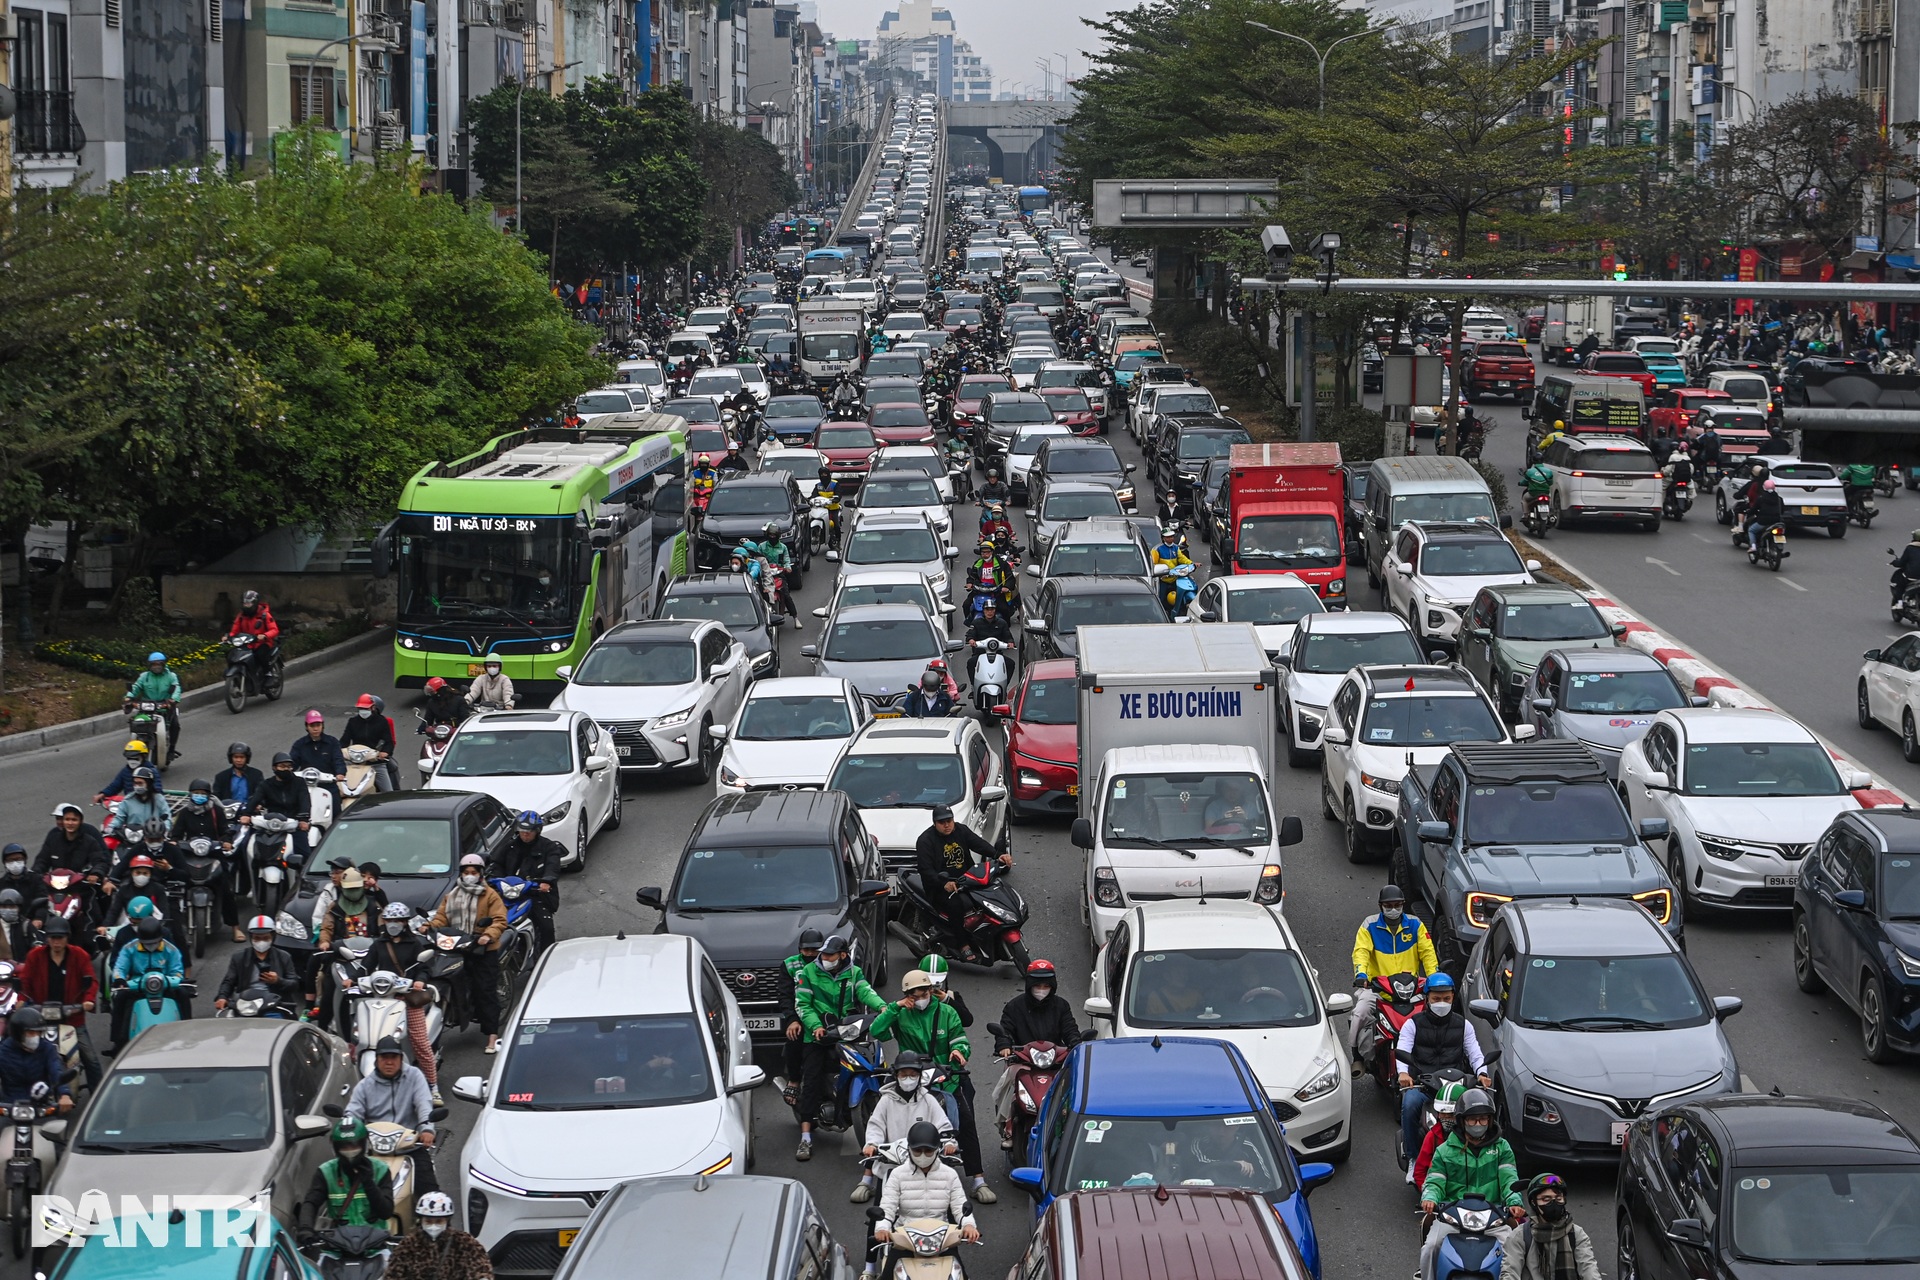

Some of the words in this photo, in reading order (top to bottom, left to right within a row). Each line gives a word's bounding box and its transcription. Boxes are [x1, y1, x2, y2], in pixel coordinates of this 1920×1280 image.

[618, 465, 634, 485] TOSHIBA
[434, 516, 451, 531] E01
[460, 517, 479, 530] NGÃ
[480, 518, 493, 530] TƯ
[516, 520, 529, 531] BX
[1120, 694, 1142, 719] XE
[1148, 690, 1182, 718] BƯU
[1186, 686, 1242, 718] CHÍNH
[1401, 932, 1412, 942] be
[508, 1093, 534, 1102] TAXI
[1616, 1134, 1622, 1144] 5
[1081, 1180, 1108, 1189] TAXI
